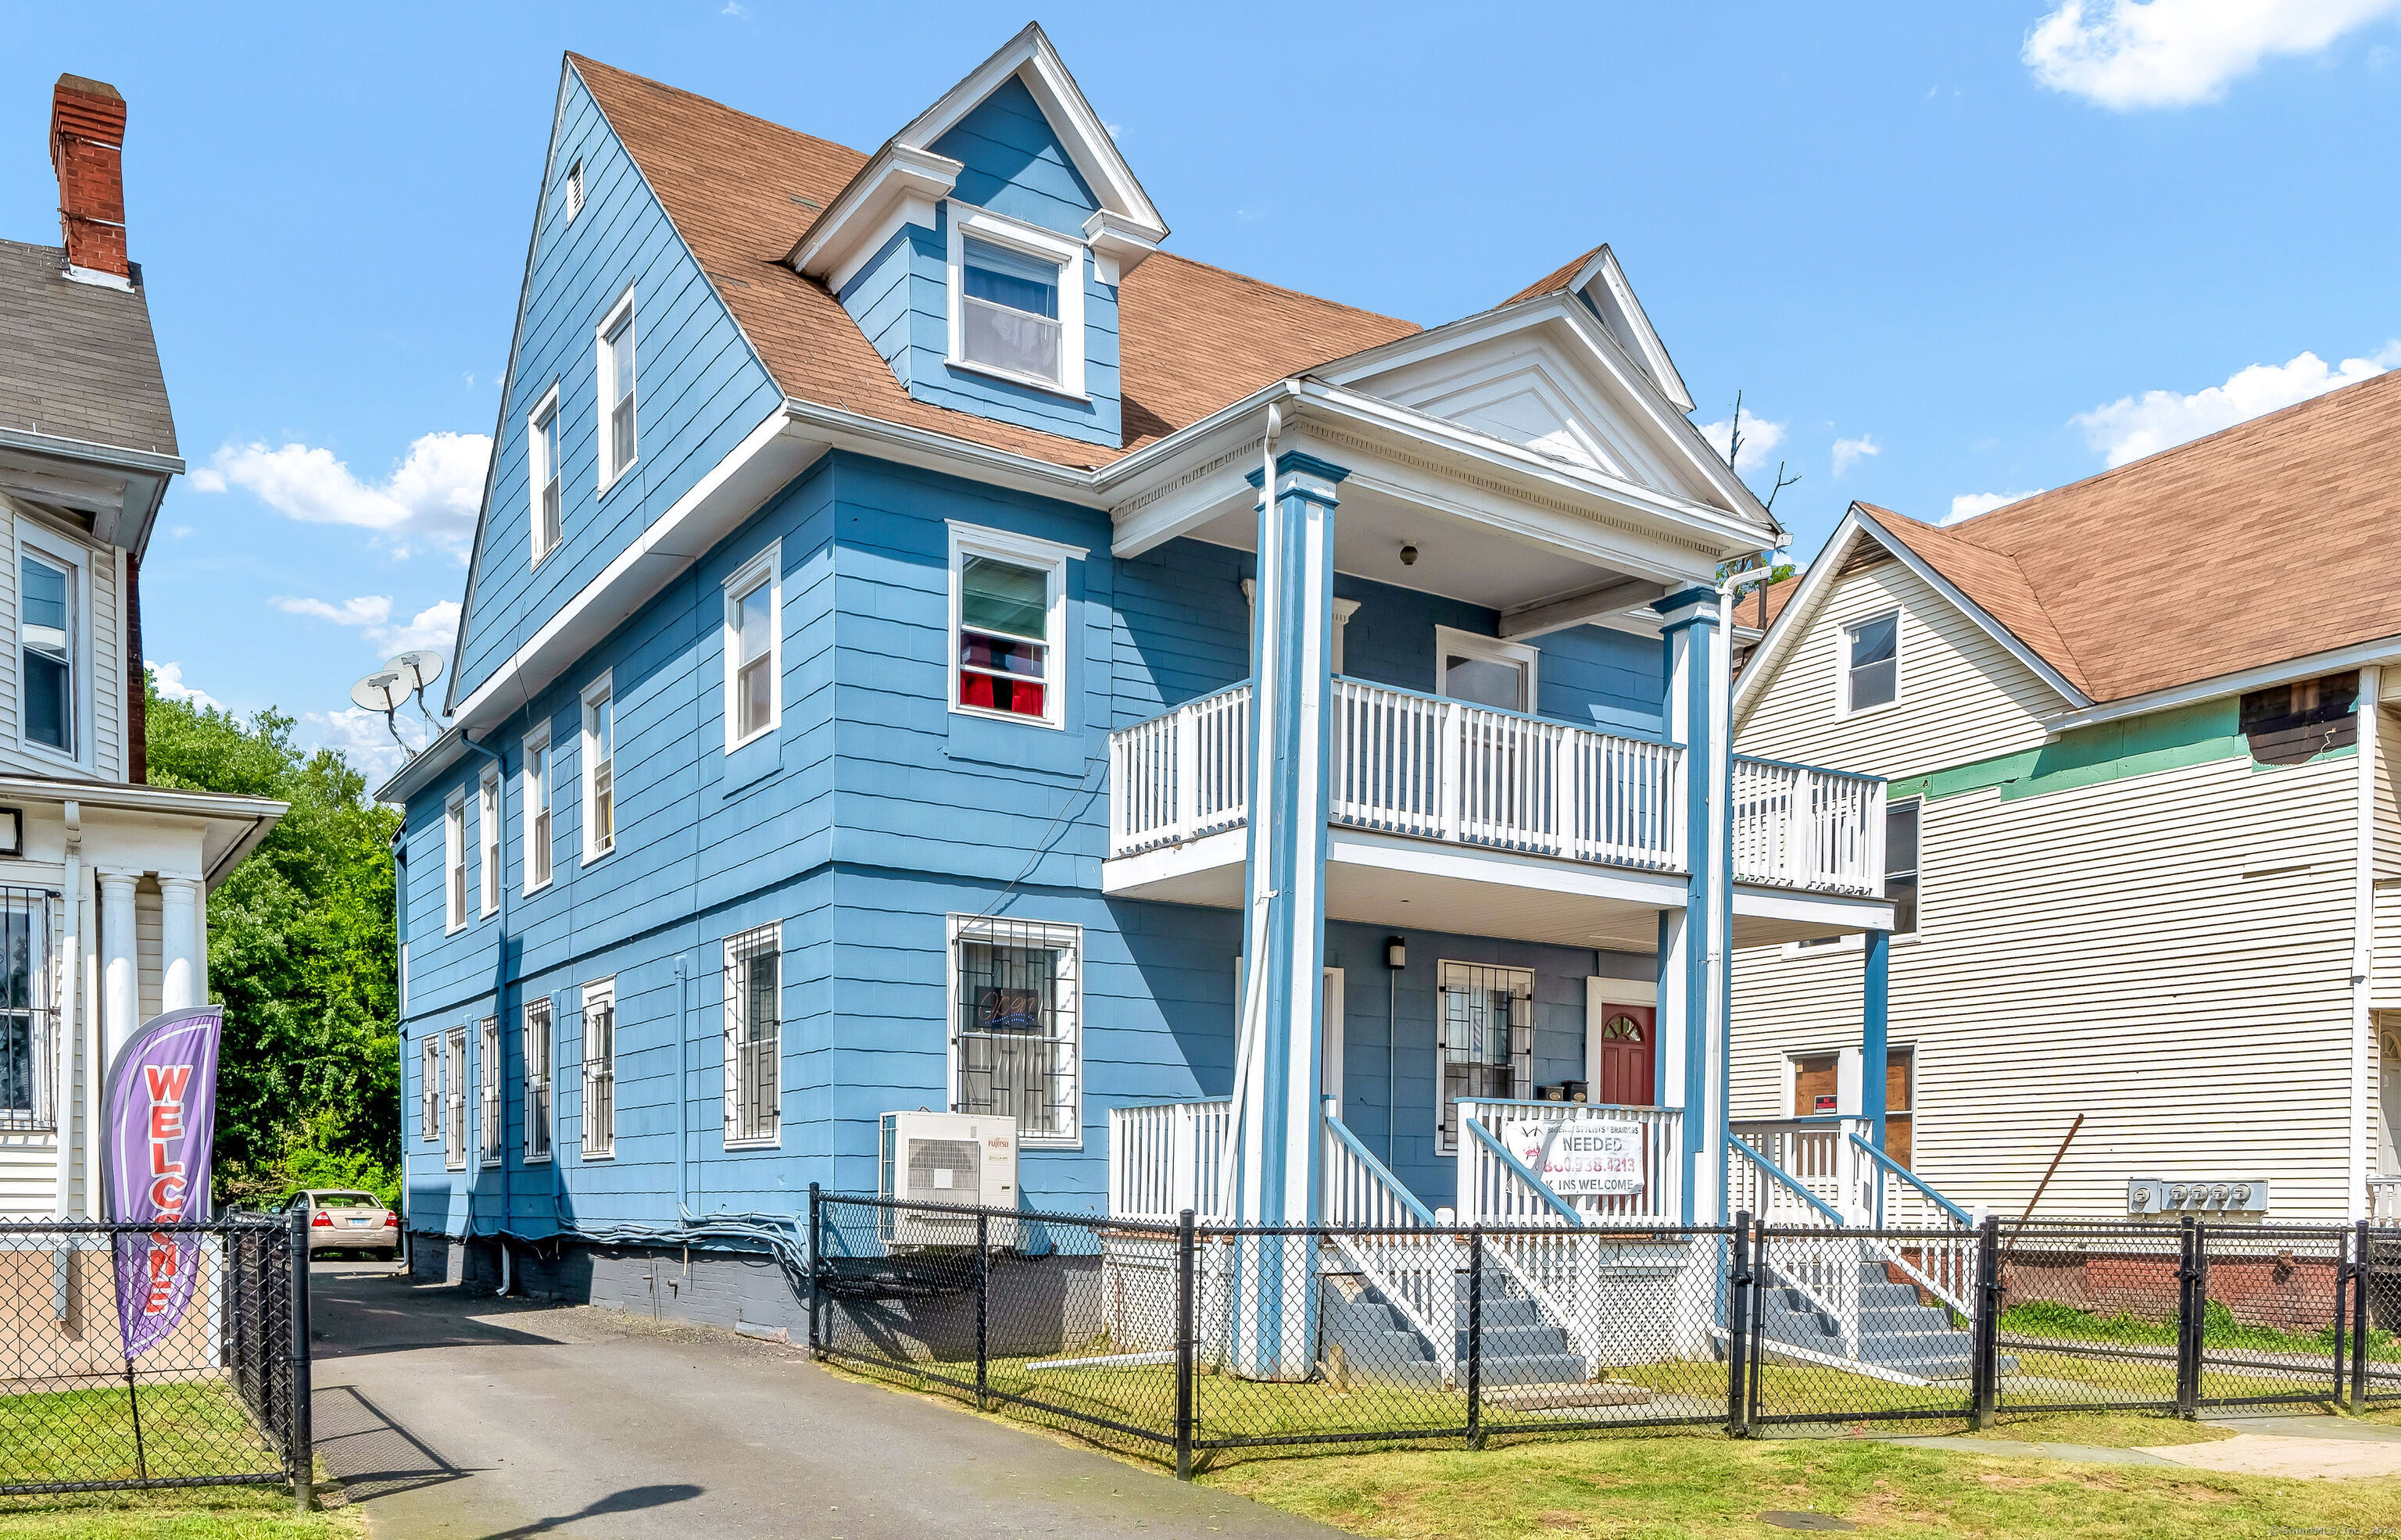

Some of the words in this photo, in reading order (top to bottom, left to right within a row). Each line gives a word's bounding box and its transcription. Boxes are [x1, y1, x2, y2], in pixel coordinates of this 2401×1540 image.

[1576, 1125, 1605, 1134] STYLISTS
[1611, 1126, 1639, 1134] BRAIDERS
[988, 1138, 1009, 1148] FUJITSU
[1562, 1137, 1622, 1151] NEEDED
[1558, 1180, 1576, 1190] INS
[1579, 1179, 1633, 1190] WELCOME
[144, 1065, 193, 1316] WELCOME
